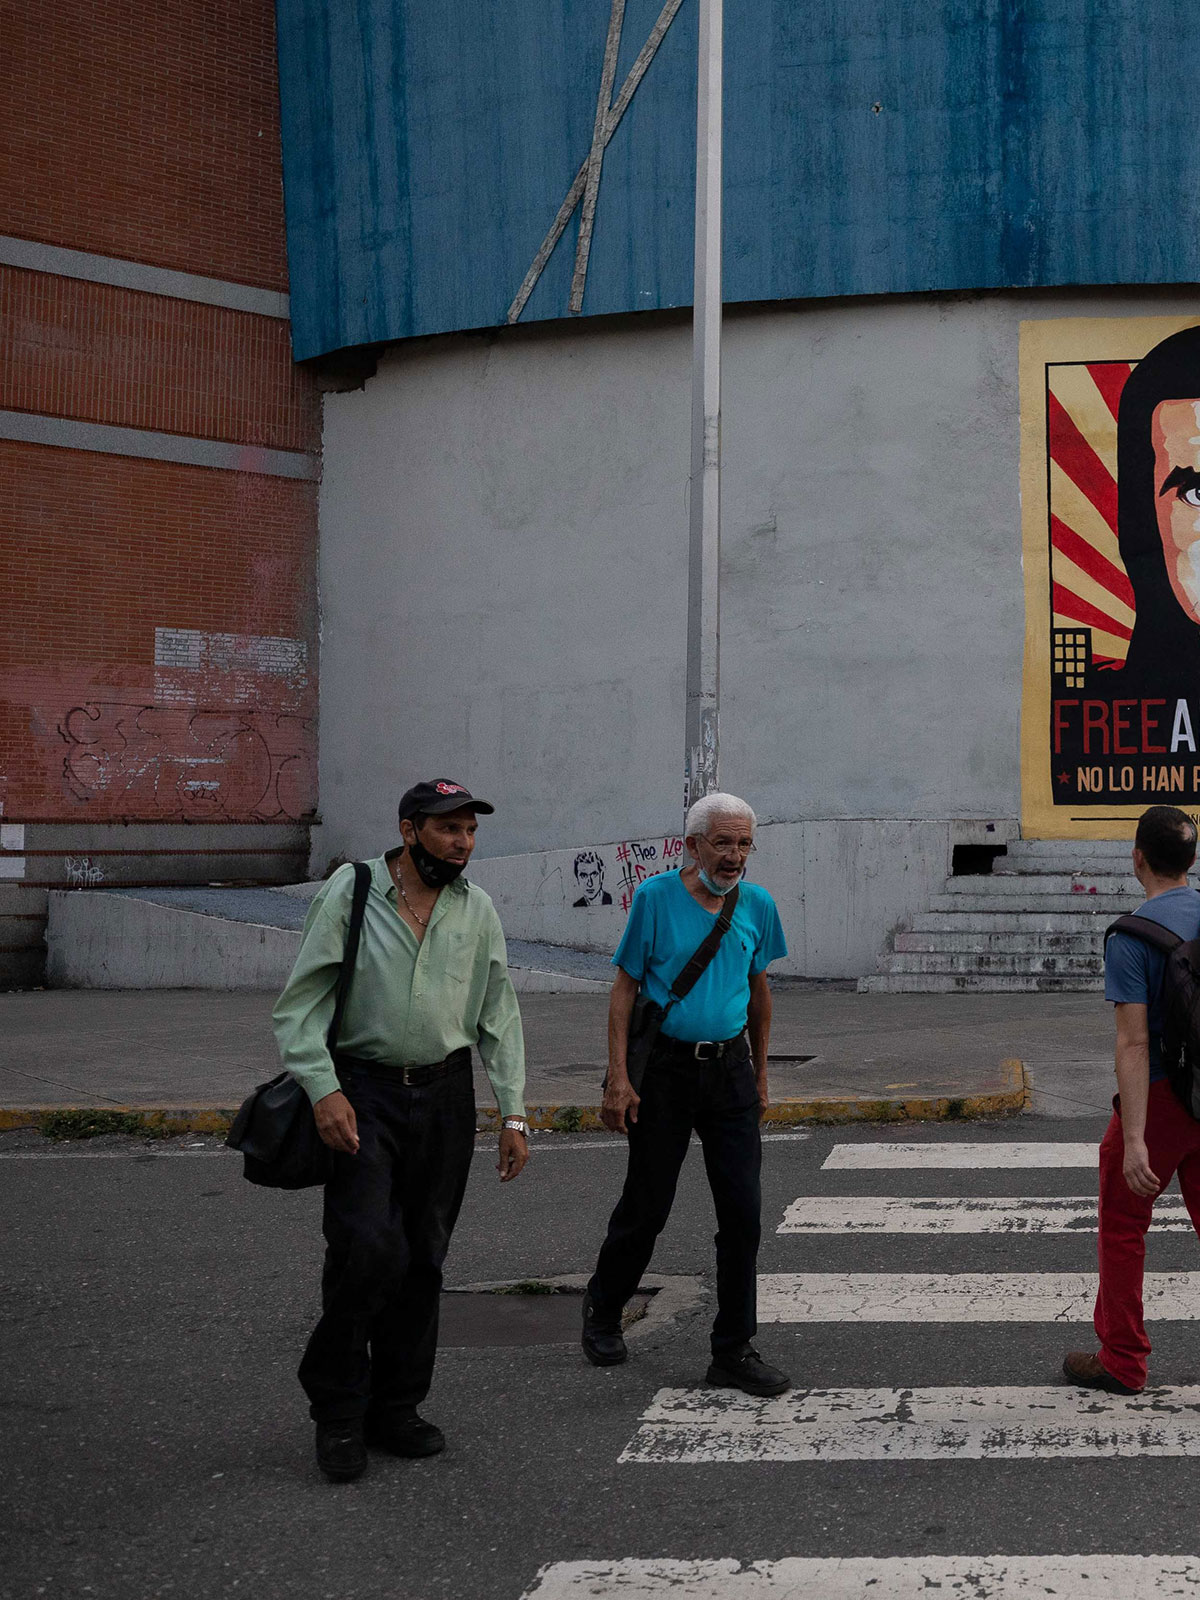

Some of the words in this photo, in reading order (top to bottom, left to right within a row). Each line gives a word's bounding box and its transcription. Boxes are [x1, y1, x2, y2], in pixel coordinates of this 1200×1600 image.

[1077, 766, 1104, 793] NO
[1108, 766, 1135, 792] LO
[1142, 765, 1185, 792] HAN
